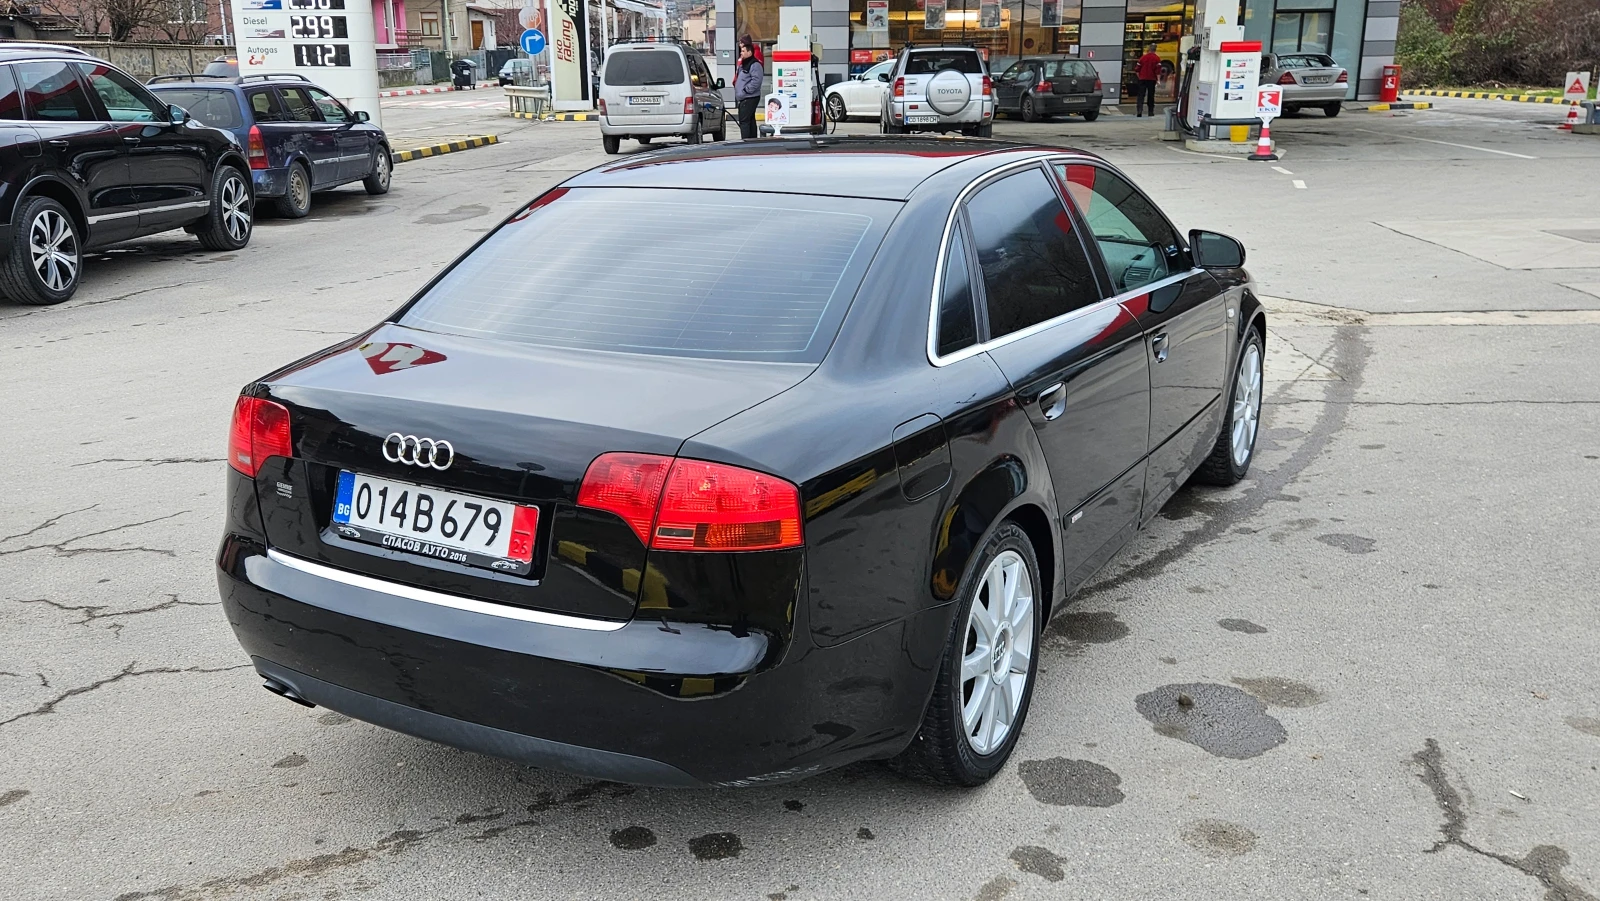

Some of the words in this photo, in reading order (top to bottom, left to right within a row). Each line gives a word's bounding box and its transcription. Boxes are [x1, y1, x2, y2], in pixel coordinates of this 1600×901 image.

[243, 16, 268, 25] Diesel
[291, 15, 334, 39] 2.99
[247, 46, 278, 55] Autogas
[556, 39, 564, 61] EKO
[562, 19, 574, 63] racing
[301, 44, 336, 67] 1.12
[337, 502, 350, 516] BG
[356, 482, 502, 547] 014B679
[382, 534, 420, 552] СПАСОВ
[422, 543, 449, 558] АУТО
[449, 551, 468, 563] 2016
[512, 538, 528, 555] 26
